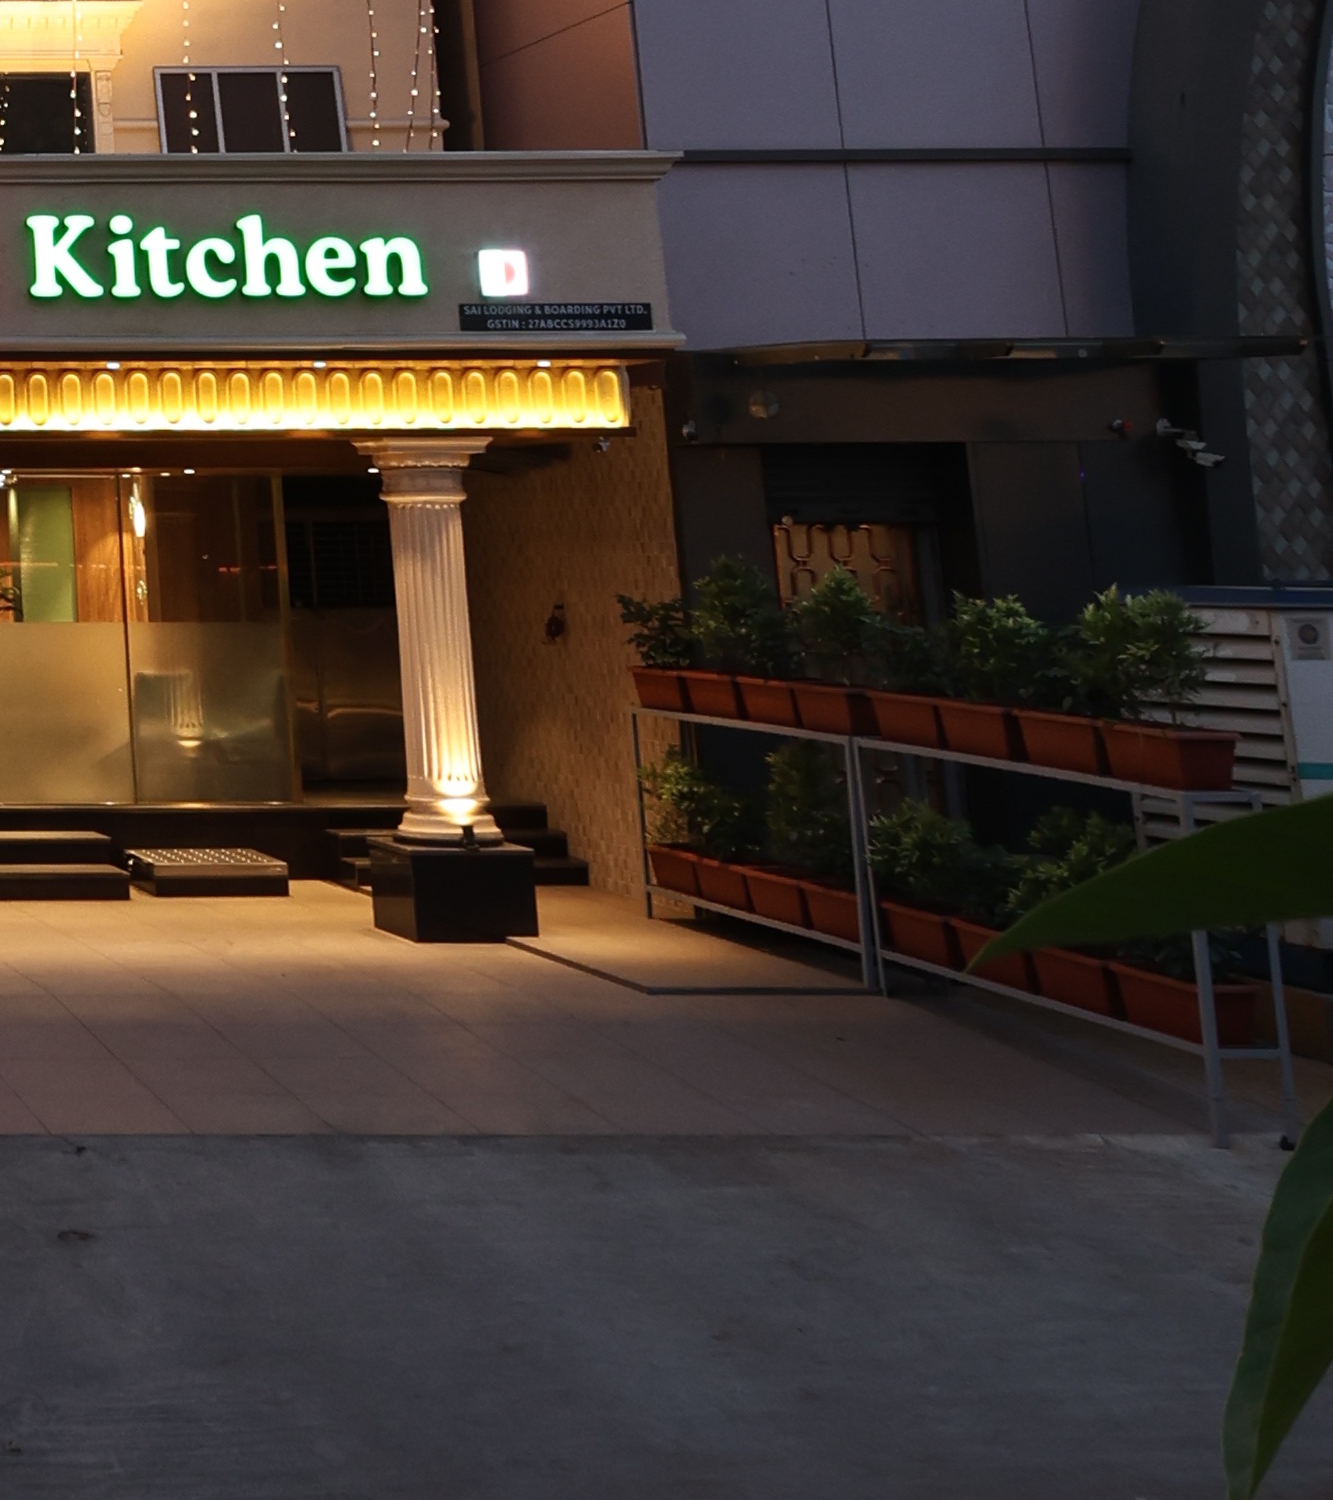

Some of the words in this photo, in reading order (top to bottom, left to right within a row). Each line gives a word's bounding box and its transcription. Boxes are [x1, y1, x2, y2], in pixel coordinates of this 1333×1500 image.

[26, 213, 429, 298] Kitchen
[463, 305, 481, 315] SAI
[483, 305, 532, 315] LODGING
[534, 305, 541, 315] &
[544, 304, 600, 315] BOARDING
[603, 304, 623, 315] PVT
[624, 304, 648, 315] LTD.
[487, 319, 520, 329] GSTIN
